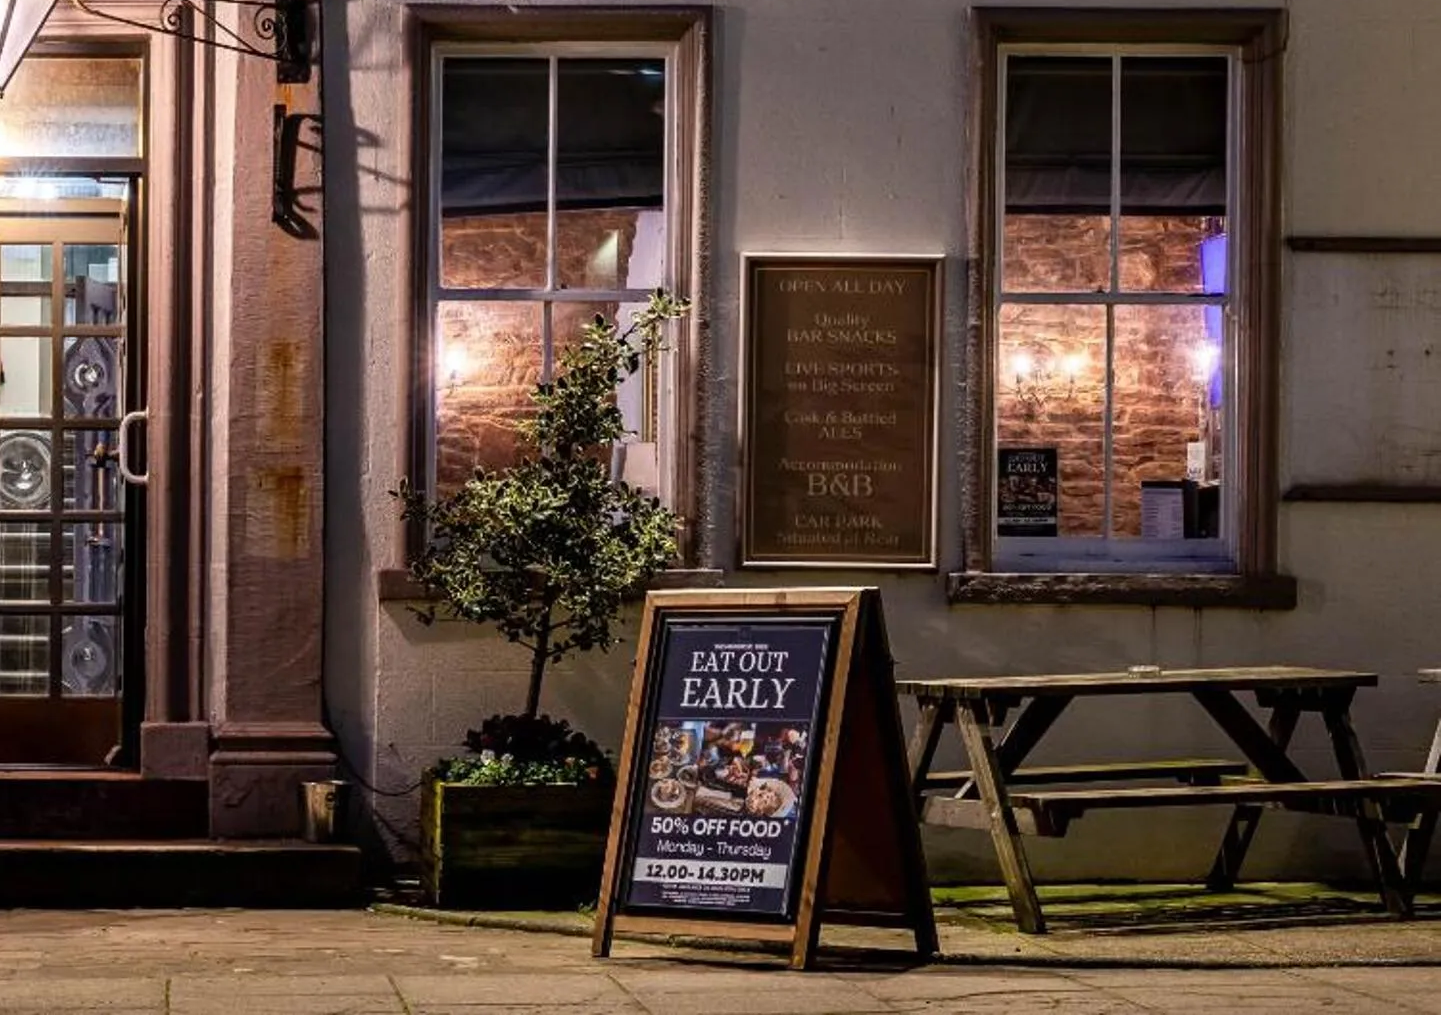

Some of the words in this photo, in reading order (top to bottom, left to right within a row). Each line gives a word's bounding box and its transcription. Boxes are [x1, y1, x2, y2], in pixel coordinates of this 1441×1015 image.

[779, 279, 826, 293] OPEN
[832, 279, 865, 294] ALL
[870, 279, 906, 295] DAY
[787, 328, 823, 343] BAR
[827, 328, 897, 345] SNACKS
[784, 361, 824, 375] LIVE
[830, 362, 899, 376] SPORTS
[841, 379, 895, 393] Screen
[841, 411, 897, 426] Bottled
[819, 425, 862, 440] ALES
[806, 472, 875, 497] B&B
[794, 514, 831, 528] CAR
[835, 514, 884, 528] PARK
[690, 651, 735, 673] EAT
[738, 651, 789, 673] OUT
[679, 677, 796, 710] EARLY
[650, 816, 689, 835] 50%
[692, 818, 726, 836] OFF
[656, 838, 705, 857] Monday
[716, 840, 772, 861] Thursday
